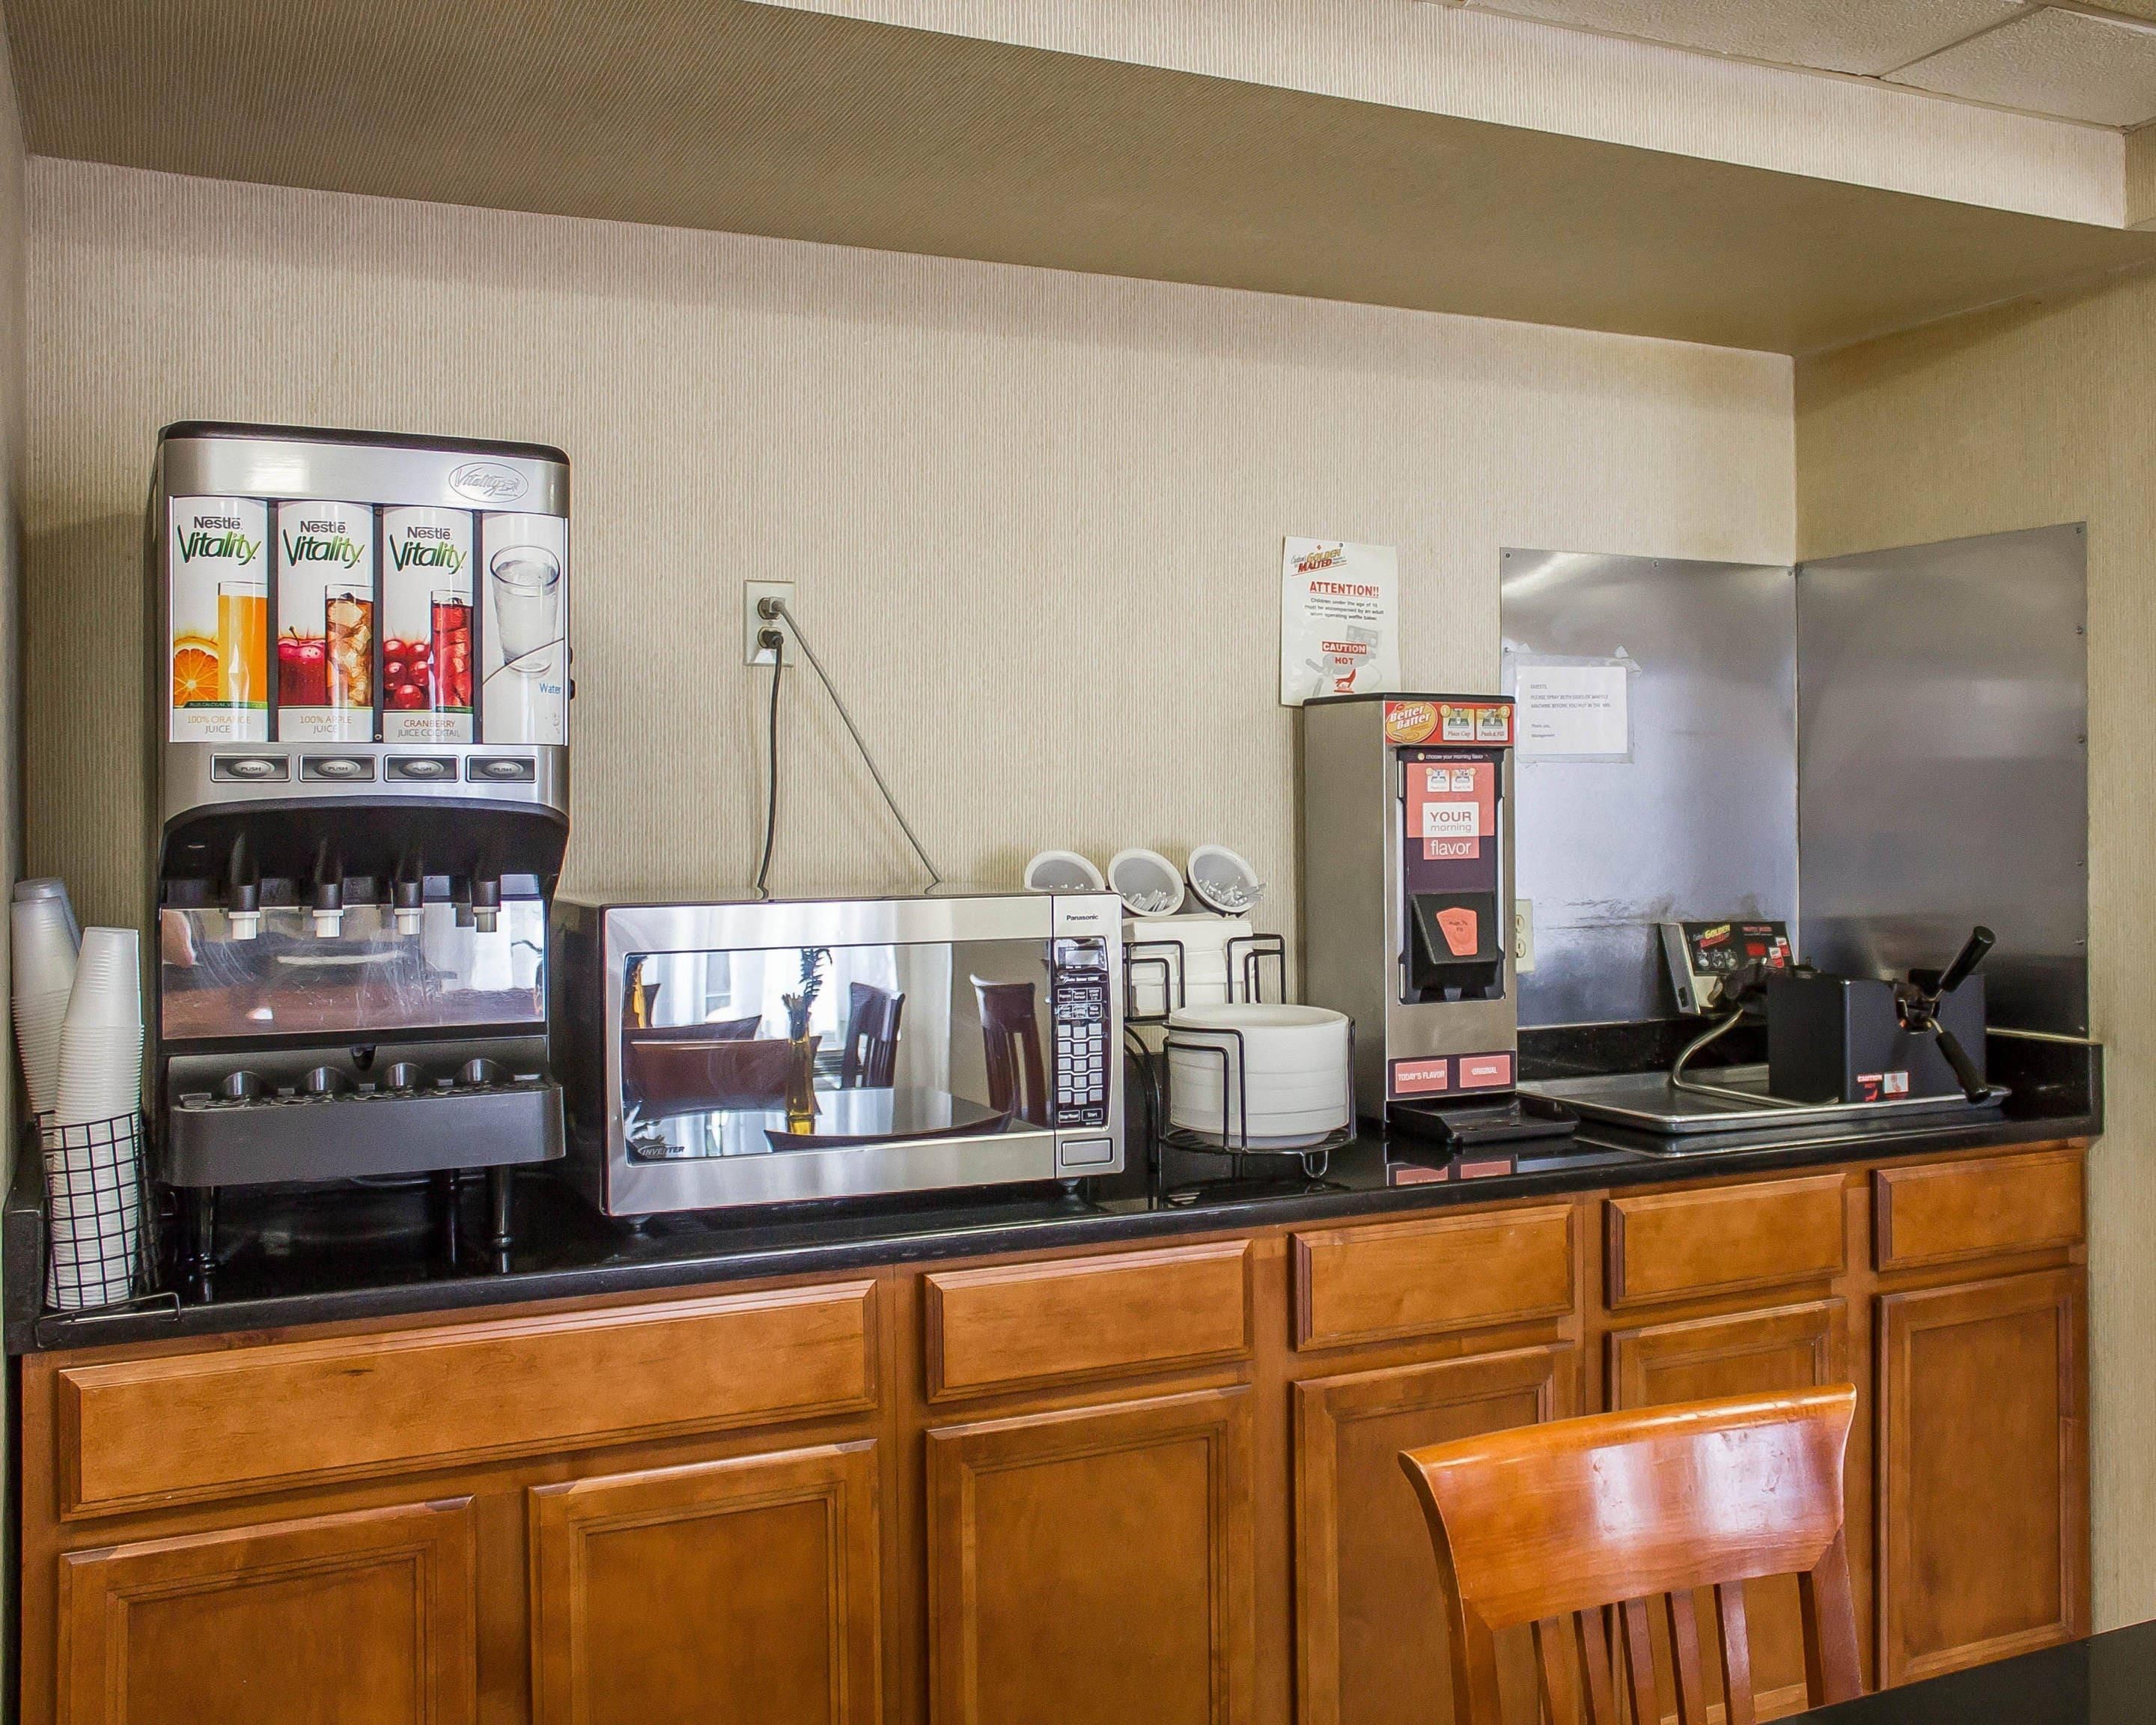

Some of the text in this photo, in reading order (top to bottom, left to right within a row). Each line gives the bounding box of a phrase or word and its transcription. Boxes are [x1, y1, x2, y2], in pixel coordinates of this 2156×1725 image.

[177, 524, 261, 566] Vitality
[283, 529, 365, 569] Vitality
[389, 534, 467, 575] Vitality
[1307, 548, 1342, 562] GOLDEN
[1298, 559, 1333, 573] MALTED
[1309, 581, 1379, 597] ATTENTION!!
[1323, 642, 1365, 654] CAUTION
[1335, 657, 1354, 665] HOT
[539, 683, 561, 694] Water
[1390, 705, 1425, 722] Better
[187, 716, 210, 724] 100%
[299, 716, 323, 724] 100%
[404, 719, 456, 728] CRANBERRY
[1396, 713, 1431, 730] Batter
[205, 725, 231, 734] JUICE
[313, 725, 337, 734] JUICE
[398, 728, 420, 737] JUICE
[1430, 812, 1472, 822] YOUR
[1431, 823, 1472, 833] morning
[1431, 839, 1472, 855] flavor
[1398, 1071, 1445, 1081] TODAY'S FLAVOR
